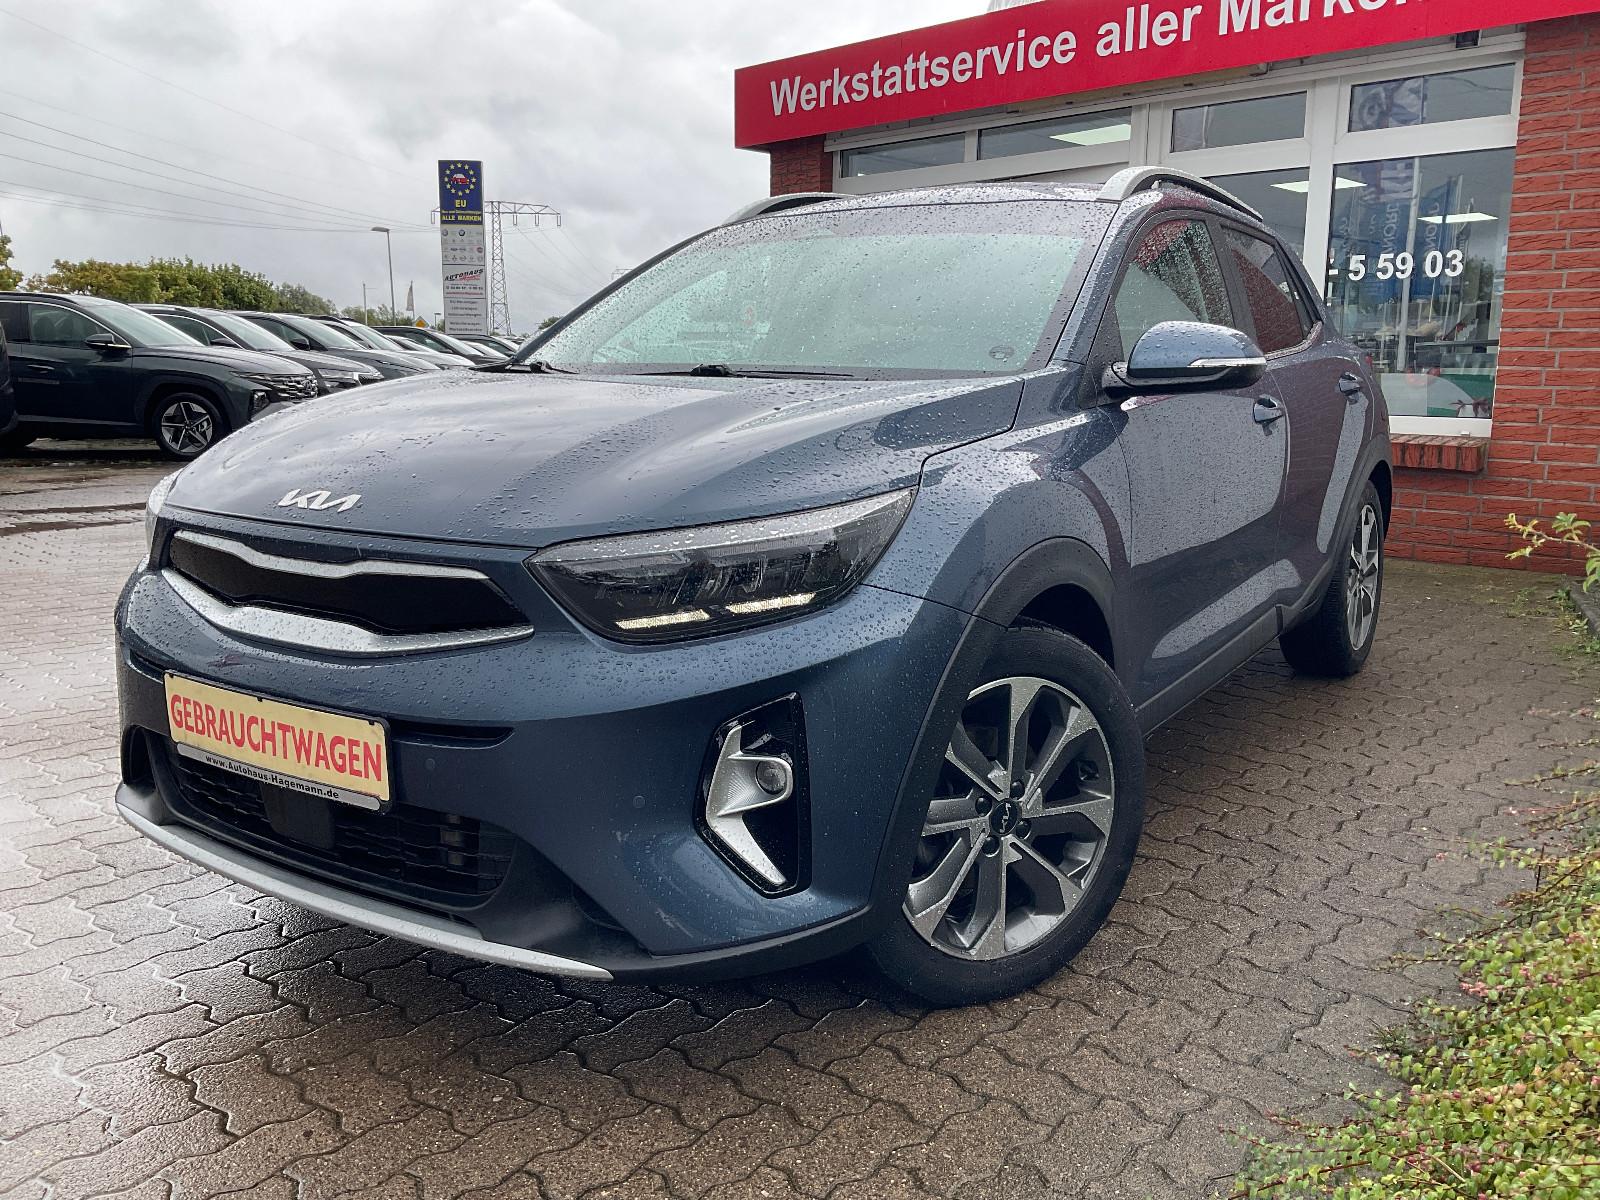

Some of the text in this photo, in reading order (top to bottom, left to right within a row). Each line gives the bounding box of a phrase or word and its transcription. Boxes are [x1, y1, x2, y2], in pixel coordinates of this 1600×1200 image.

[769, 28, 1077, 117] Werkstattservice
[1096, 3, 1202, 58] aller
[455, 199, 467, 208] EU
[445, 268, 484, 282] AUTOHAUS
[1348, 254, 1366, 281] 5
[1376, 251, 1414, 280] 59
[1424, 249, 1464, 278] 03
[277, 488, 362, 513] KIA
[170, 693, 382, 782] GEBRAUCHTWAGEN
[205, 754, 340, 799] www.Autohaus-Hagemann.de
